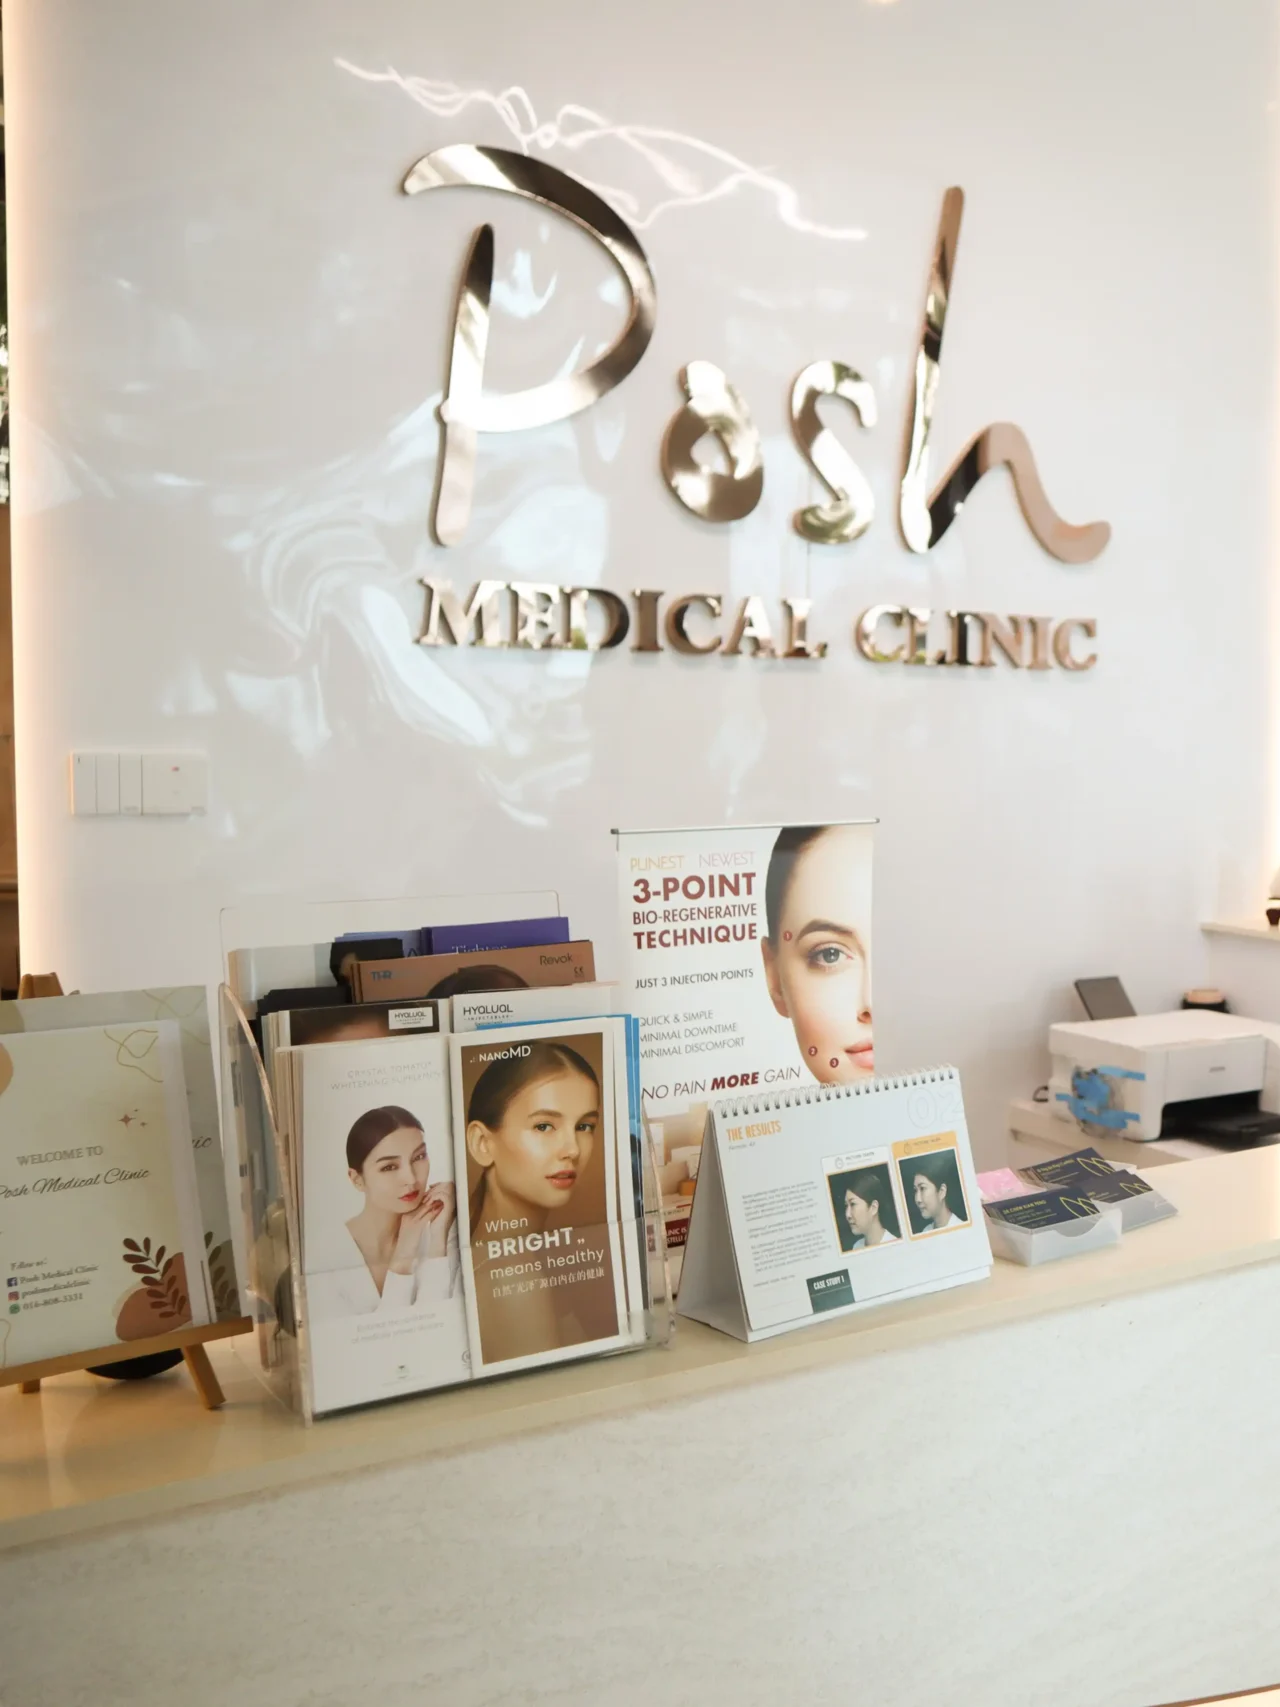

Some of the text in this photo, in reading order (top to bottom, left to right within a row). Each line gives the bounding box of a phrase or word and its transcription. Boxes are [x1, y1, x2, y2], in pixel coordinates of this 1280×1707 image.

[399, 143, 1112, 565] Posh
[414, 575, 1100, 673] MEDICAL CLINIC
[699, 851, 756, 868] NEWEST
[632, 872, 757, 904] 3-POINT
[632, 903, 758, 925] BIO-REGENERATIVE
[632, 922, 758, 950] TECHNIQUE
[635, 968, 754, 989] JUST 3 INJECTION POINTS
[640, 1009, 714, 1026] QUICK & SIMPLE
[684, 1022, 737, 1038] DOWNTIME
[685, 1037, 745, 1054] DISCOMFORT
[641, 1065, 801, 1100] NO PAIN MORE GAIN
[725, 1119, 782, 1141] THE RESULTS
[16, 1145, 103, 1166] WELCOME TO
[0, 1168, 150, 1199] Posh Medical Clinic
[485, 1217, 528, 1233] When
[490, 1248, 604, 1280] means healthy
[813, 1279, 826, 1291] CASE
[826, 1275, 840, 1287] STUDY
